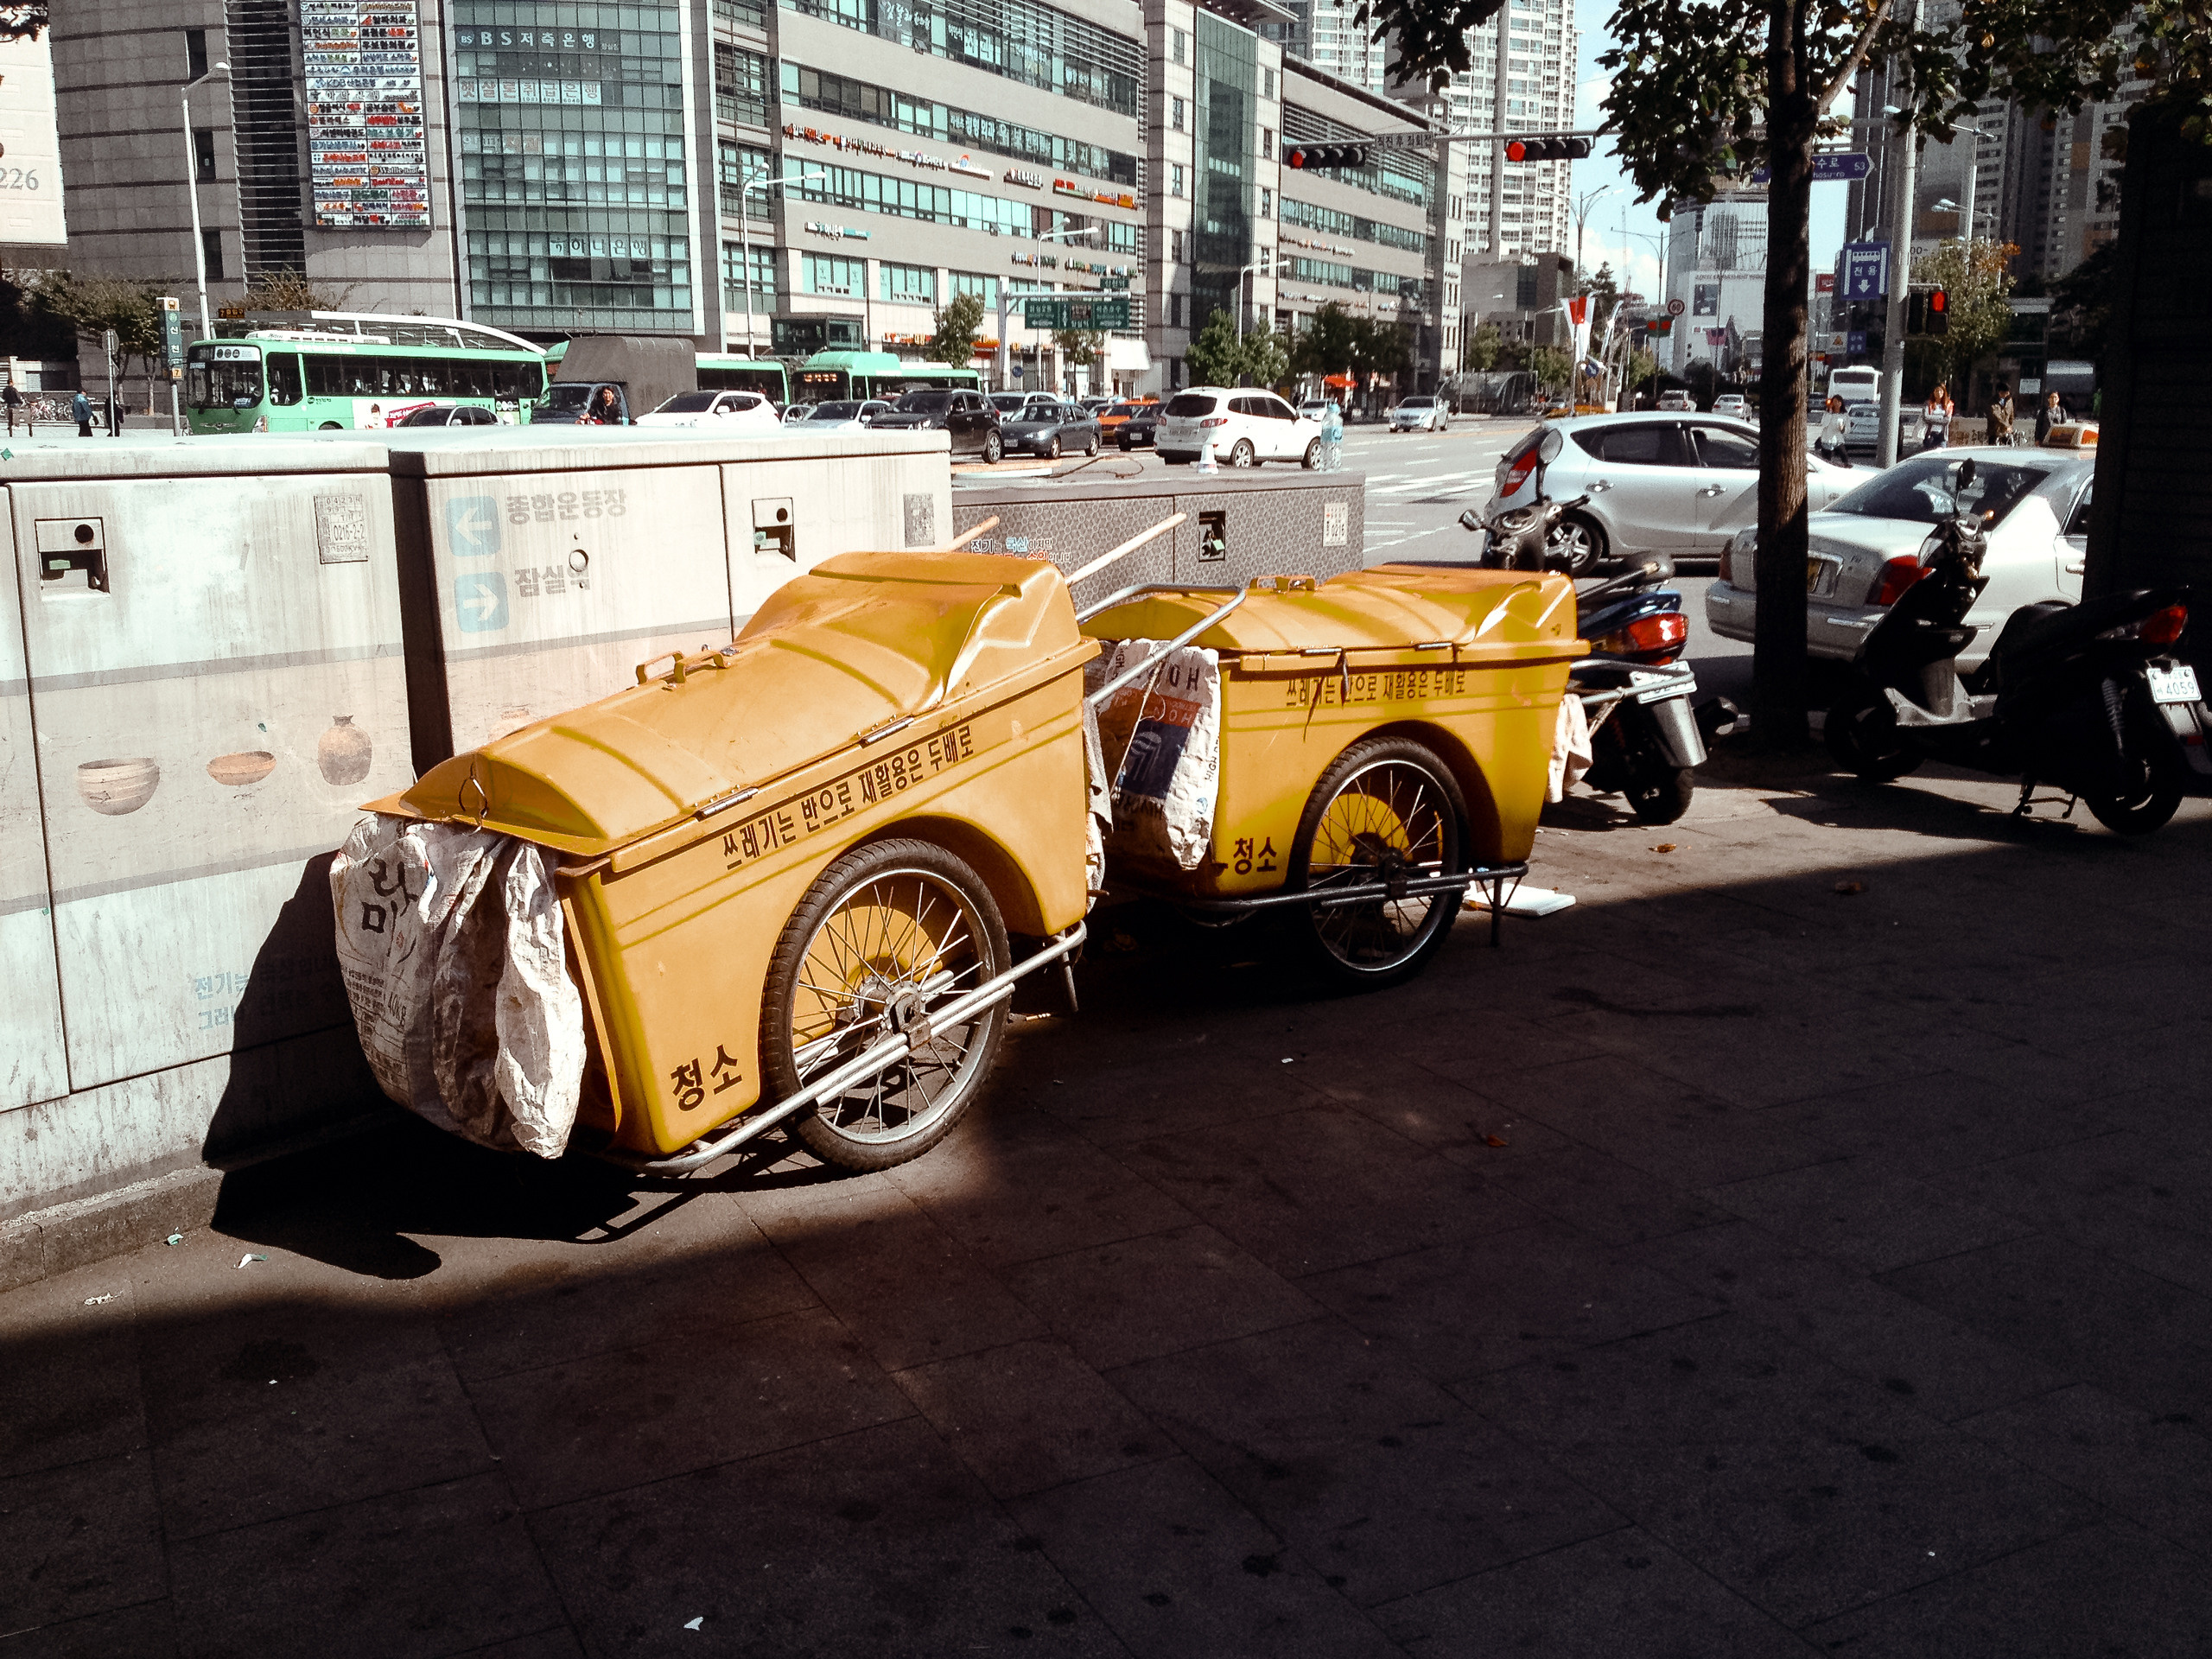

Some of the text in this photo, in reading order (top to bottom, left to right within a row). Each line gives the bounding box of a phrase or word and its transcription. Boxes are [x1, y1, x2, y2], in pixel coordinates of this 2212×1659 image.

[1377, 135, 1394, 148] 직진
[1816, 157, 1840, 169] 수로
[506, 488, 627, 525] 종합운동장
[970, 536, 1053, 554] 전기는 국산이지만
[514, 564, 591, 599] 잠실역
[1382, 671, 1429, 701] 재활용은
[1433, 669, 1466, 697] 두배로
[2166, 681, 2195, 695] 4059
[721, 725, 975, 870] 쓰레기는 반으로 재활용은 두배로
[1234, 836, 1278, 876] 청소
[671, 1044, 743, 1113] 청소
